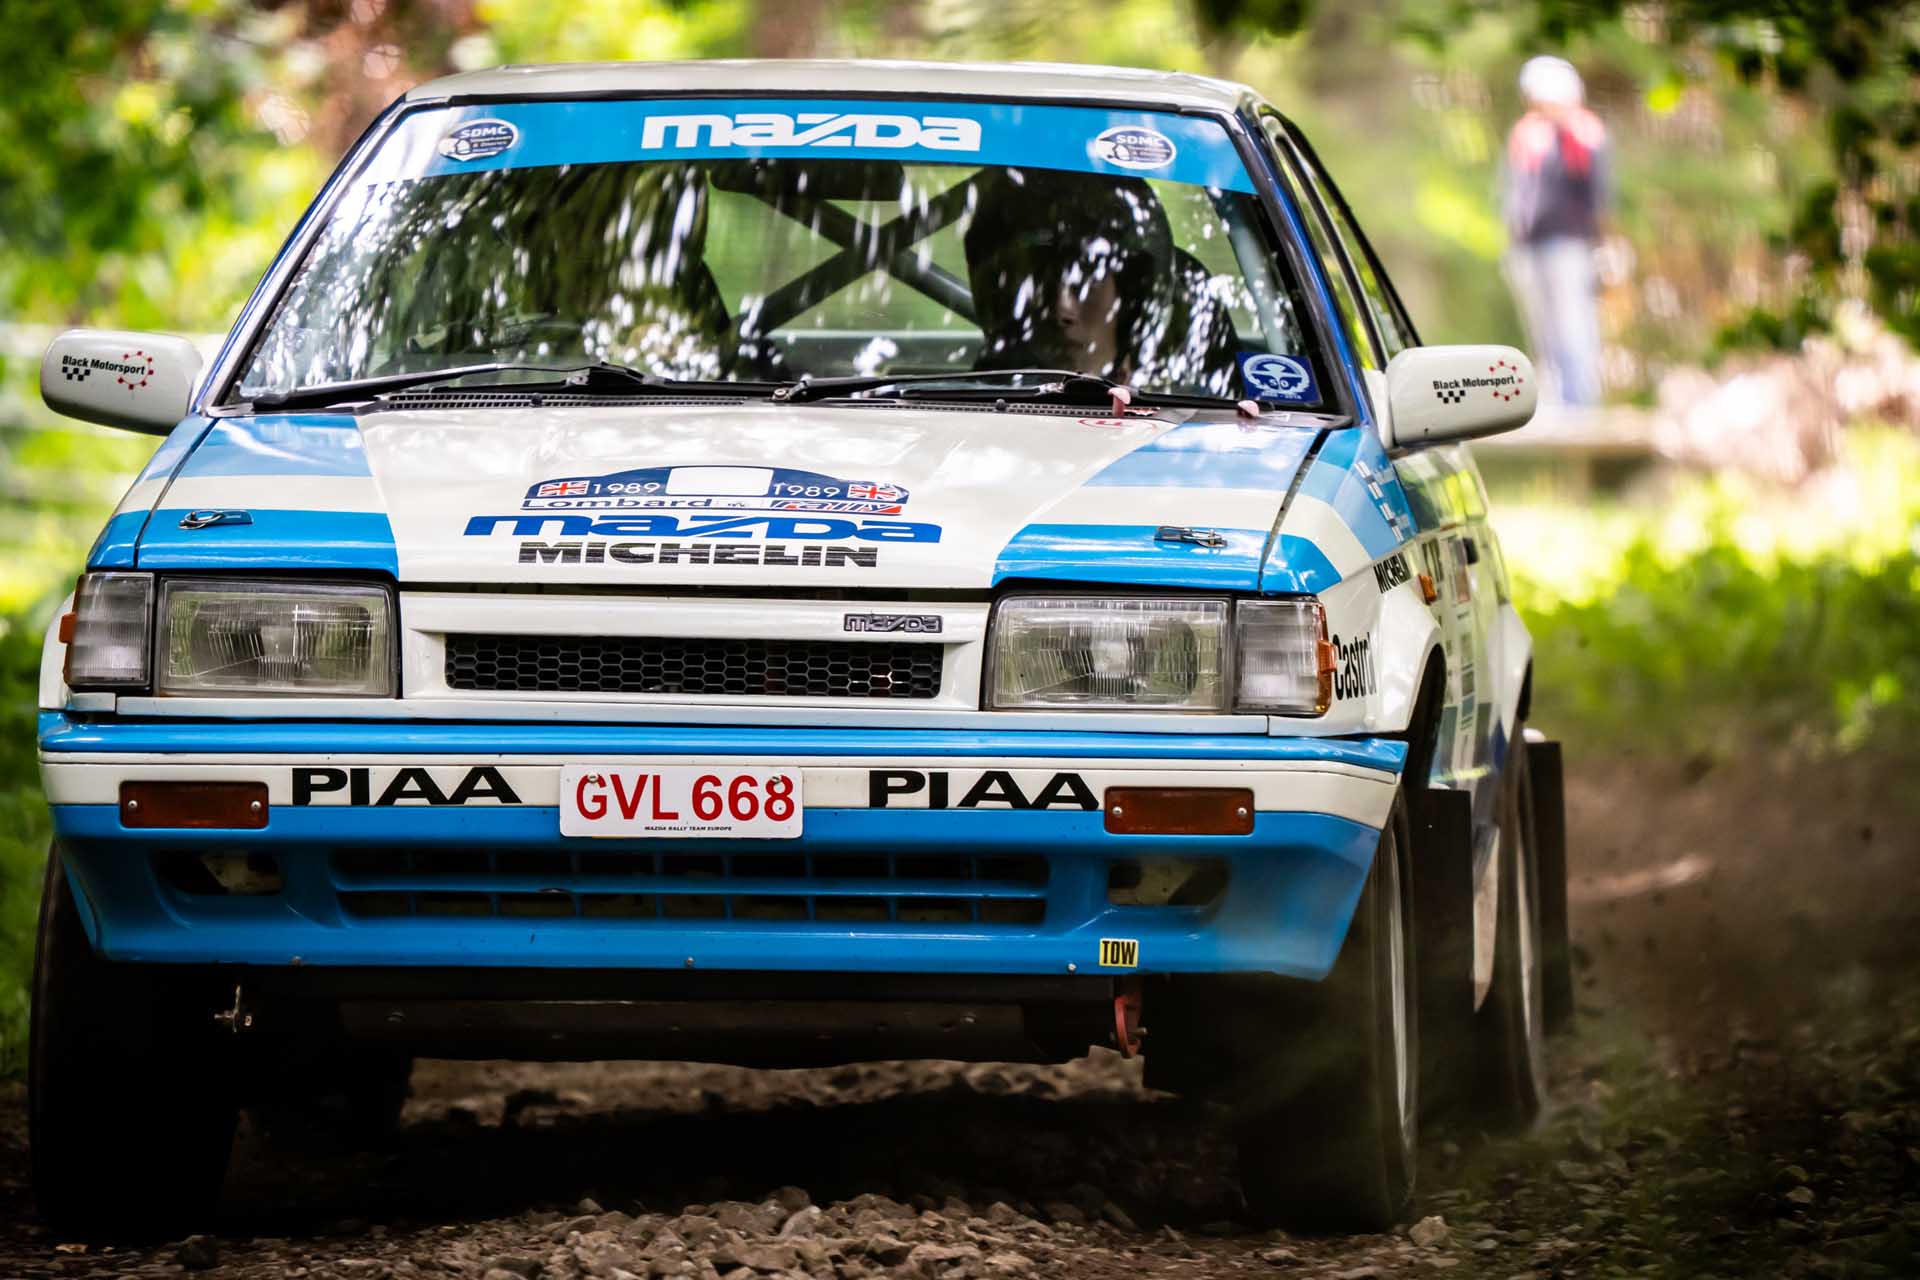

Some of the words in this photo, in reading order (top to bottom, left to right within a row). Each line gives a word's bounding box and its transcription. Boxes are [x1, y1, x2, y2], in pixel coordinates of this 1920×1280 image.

[461, 126, 508, 139] SDMC
[62, 355, 88, 367] Black
[90, 359, 145, 375] Motorsport
[1432, 378, 1460, 389] Black
[1462, 376, 1515, 388] Motorsport
[593, 482, 661, 494] 1989
[772, 483, 840, 498] 1989
[522, 498, 712, 508] Lombard
[770, 500, 891, 513] rally
[518, 542, 878, 567] MICHELIN
[292, 766, 522, 806] PIAA
[868, 769, 1099, 810] PIAA
[576, 774, 679, 820] GVL
[692, 774, 795, 822] 668
[1102, 940, 1136, 965] TOW
